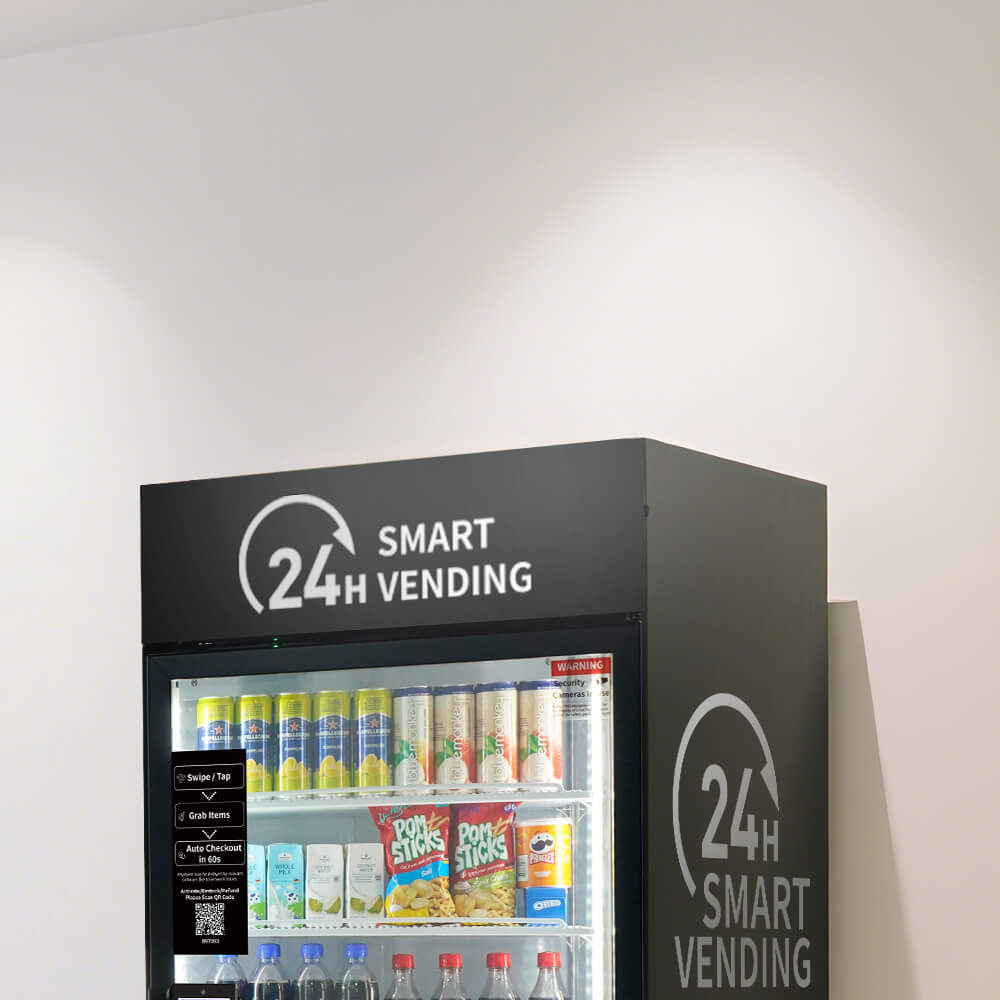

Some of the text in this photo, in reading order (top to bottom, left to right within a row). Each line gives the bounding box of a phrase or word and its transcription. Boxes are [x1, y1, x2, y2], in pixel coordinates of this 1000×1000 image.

[378, 517, 495, 557] SMART
[376, 561, 532, 602] VENDING
[557, 660, 604, 672] WARNING
[554, 679, 585, 688] Security
[552, 690, 585, 699] Cameras
[187, 772, 211, 783] Swipe
[216, 772, 231, 782] Tap
[188, 811, 231, 820] Grab Items
[391, 814, 428, 842] POM
[457, 821, 493, 848] POM
[186, 843, 242, 853] Auto Checkout
[208, 855, 221, 864] 60s
[702, 872, 811, 930] SMART
[674, 935, 811, 988] VENDING
